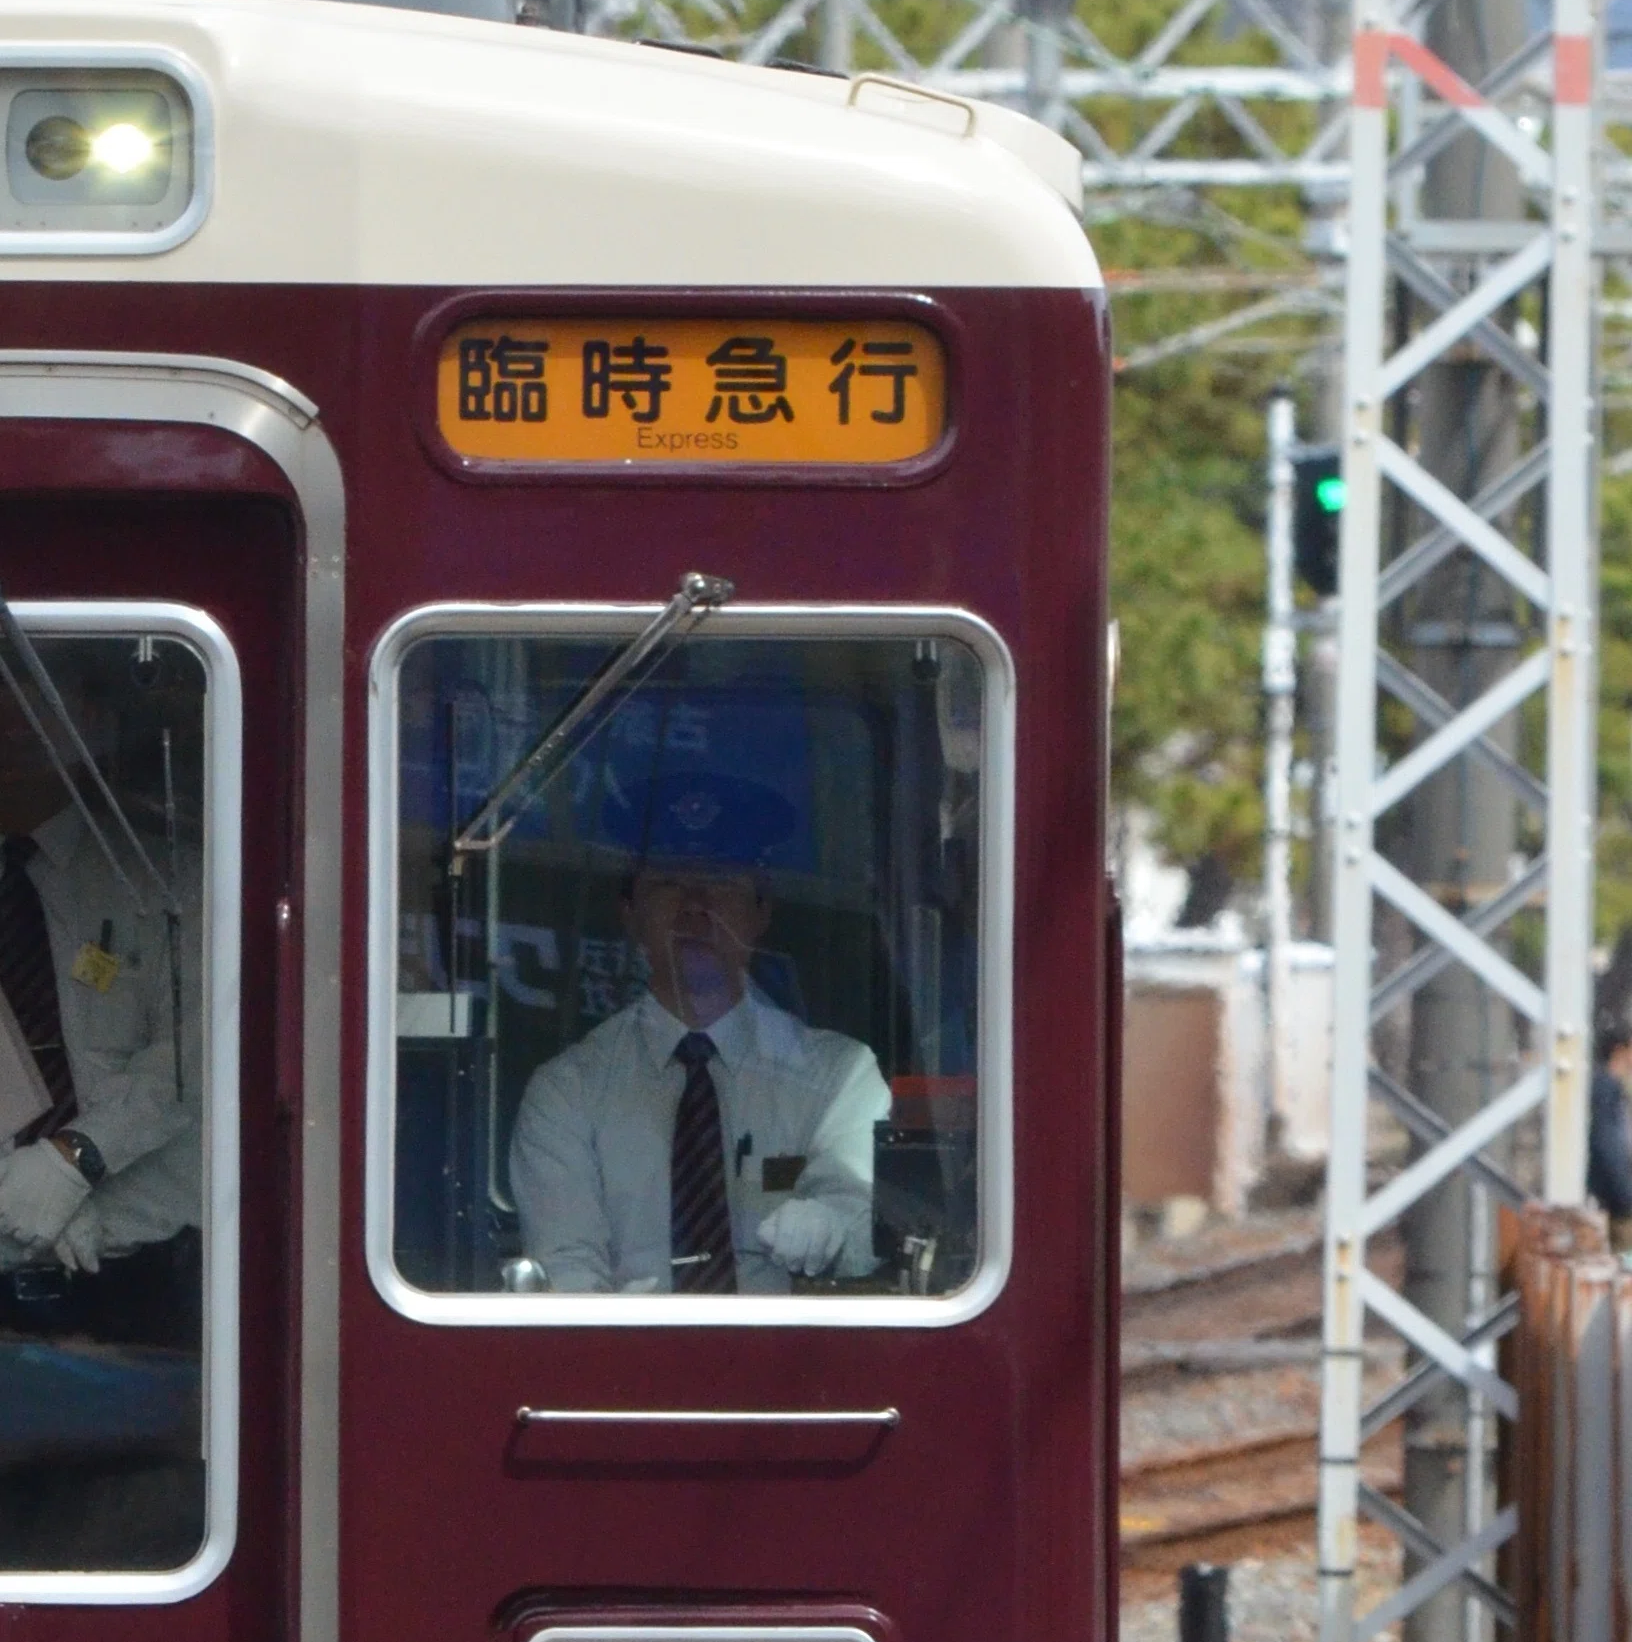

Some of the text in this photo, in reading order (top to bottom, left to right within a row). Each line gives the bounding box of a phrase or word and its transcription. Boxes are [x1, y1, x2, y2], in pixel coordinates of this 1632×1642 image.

[458, 335, 919, 425] 臨時急行
[636, 427, 739, 452] Express
